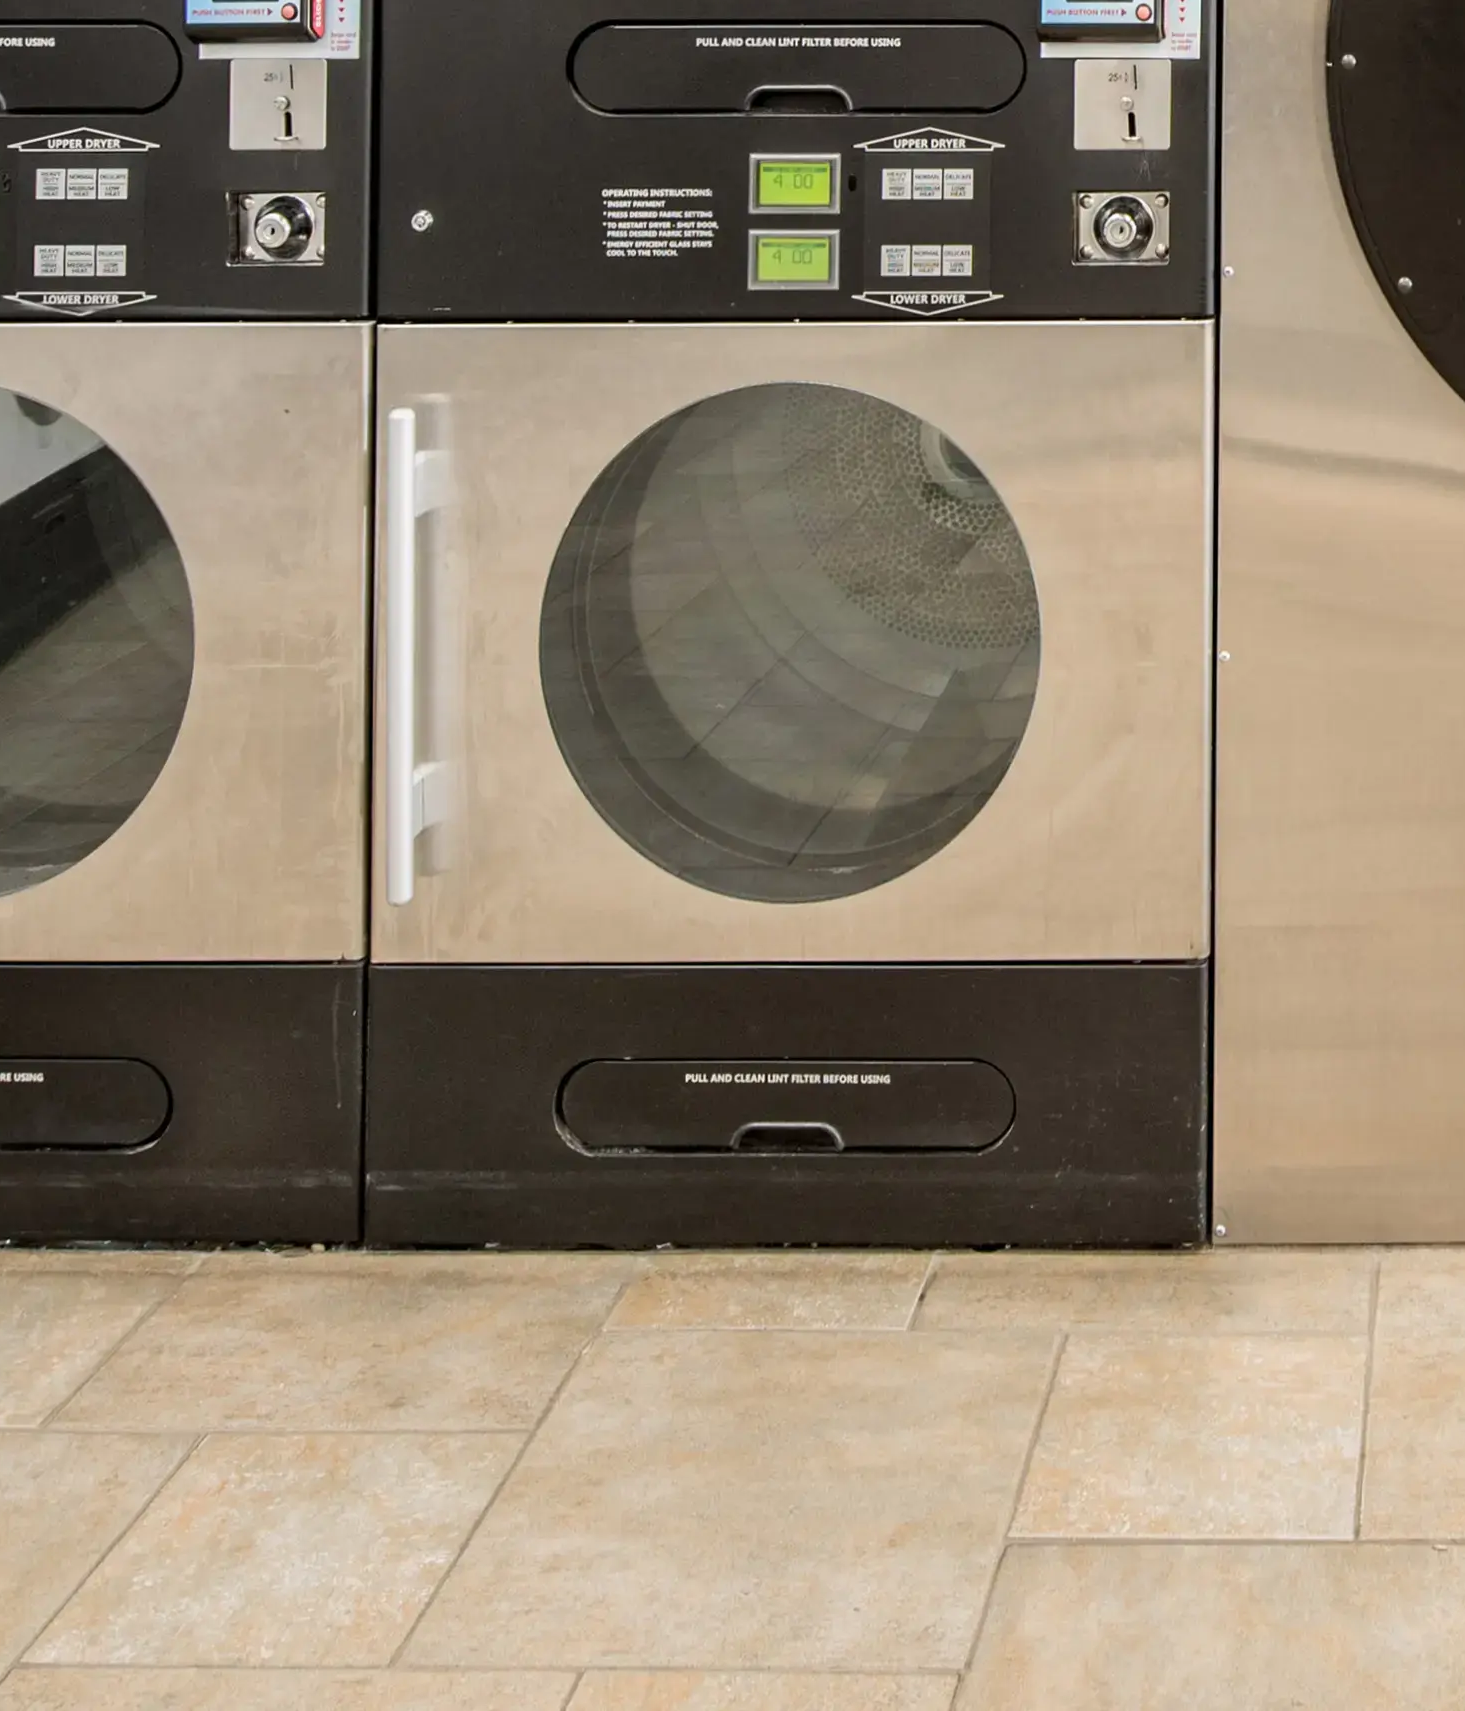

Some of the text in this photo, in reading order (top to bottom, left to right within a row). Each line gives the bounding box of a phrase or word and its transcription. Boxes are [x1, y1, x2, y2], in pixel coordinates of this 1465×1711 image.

[24, 37, 56, 48] USING
[695, 37, 902, 48] PULL AND CLEAN LINT FILTER BEFORE USING
[47, 139, 121, 149] UPPER DRYER
[893, 138, 966, 149] UPPER DRYER
[601, 188, 713, 198] OPERATING INSTRUCTIONS:
[607, 200, 666, 208] INSERT PAYMENT
[607, 221, 618, 229] TO
[617, 221, 648, 229] RESTART
[606, 240, 713, 249] ENERGY EFFICIENT GLASS STAYS
[606, 249, 626, 257] COOL
[626, 249, 637, 257] TO
[637, 249, 652, 257] THE
[42, 295, 120, 305] LOWER DRYER
[890, 294, 966, 304] LOWER DRYER
[13, 1072, 45, 1083] USING
[684, 1073, 891, 1085] PULL AND CLEAN LINT FILTER BEFORE USING
